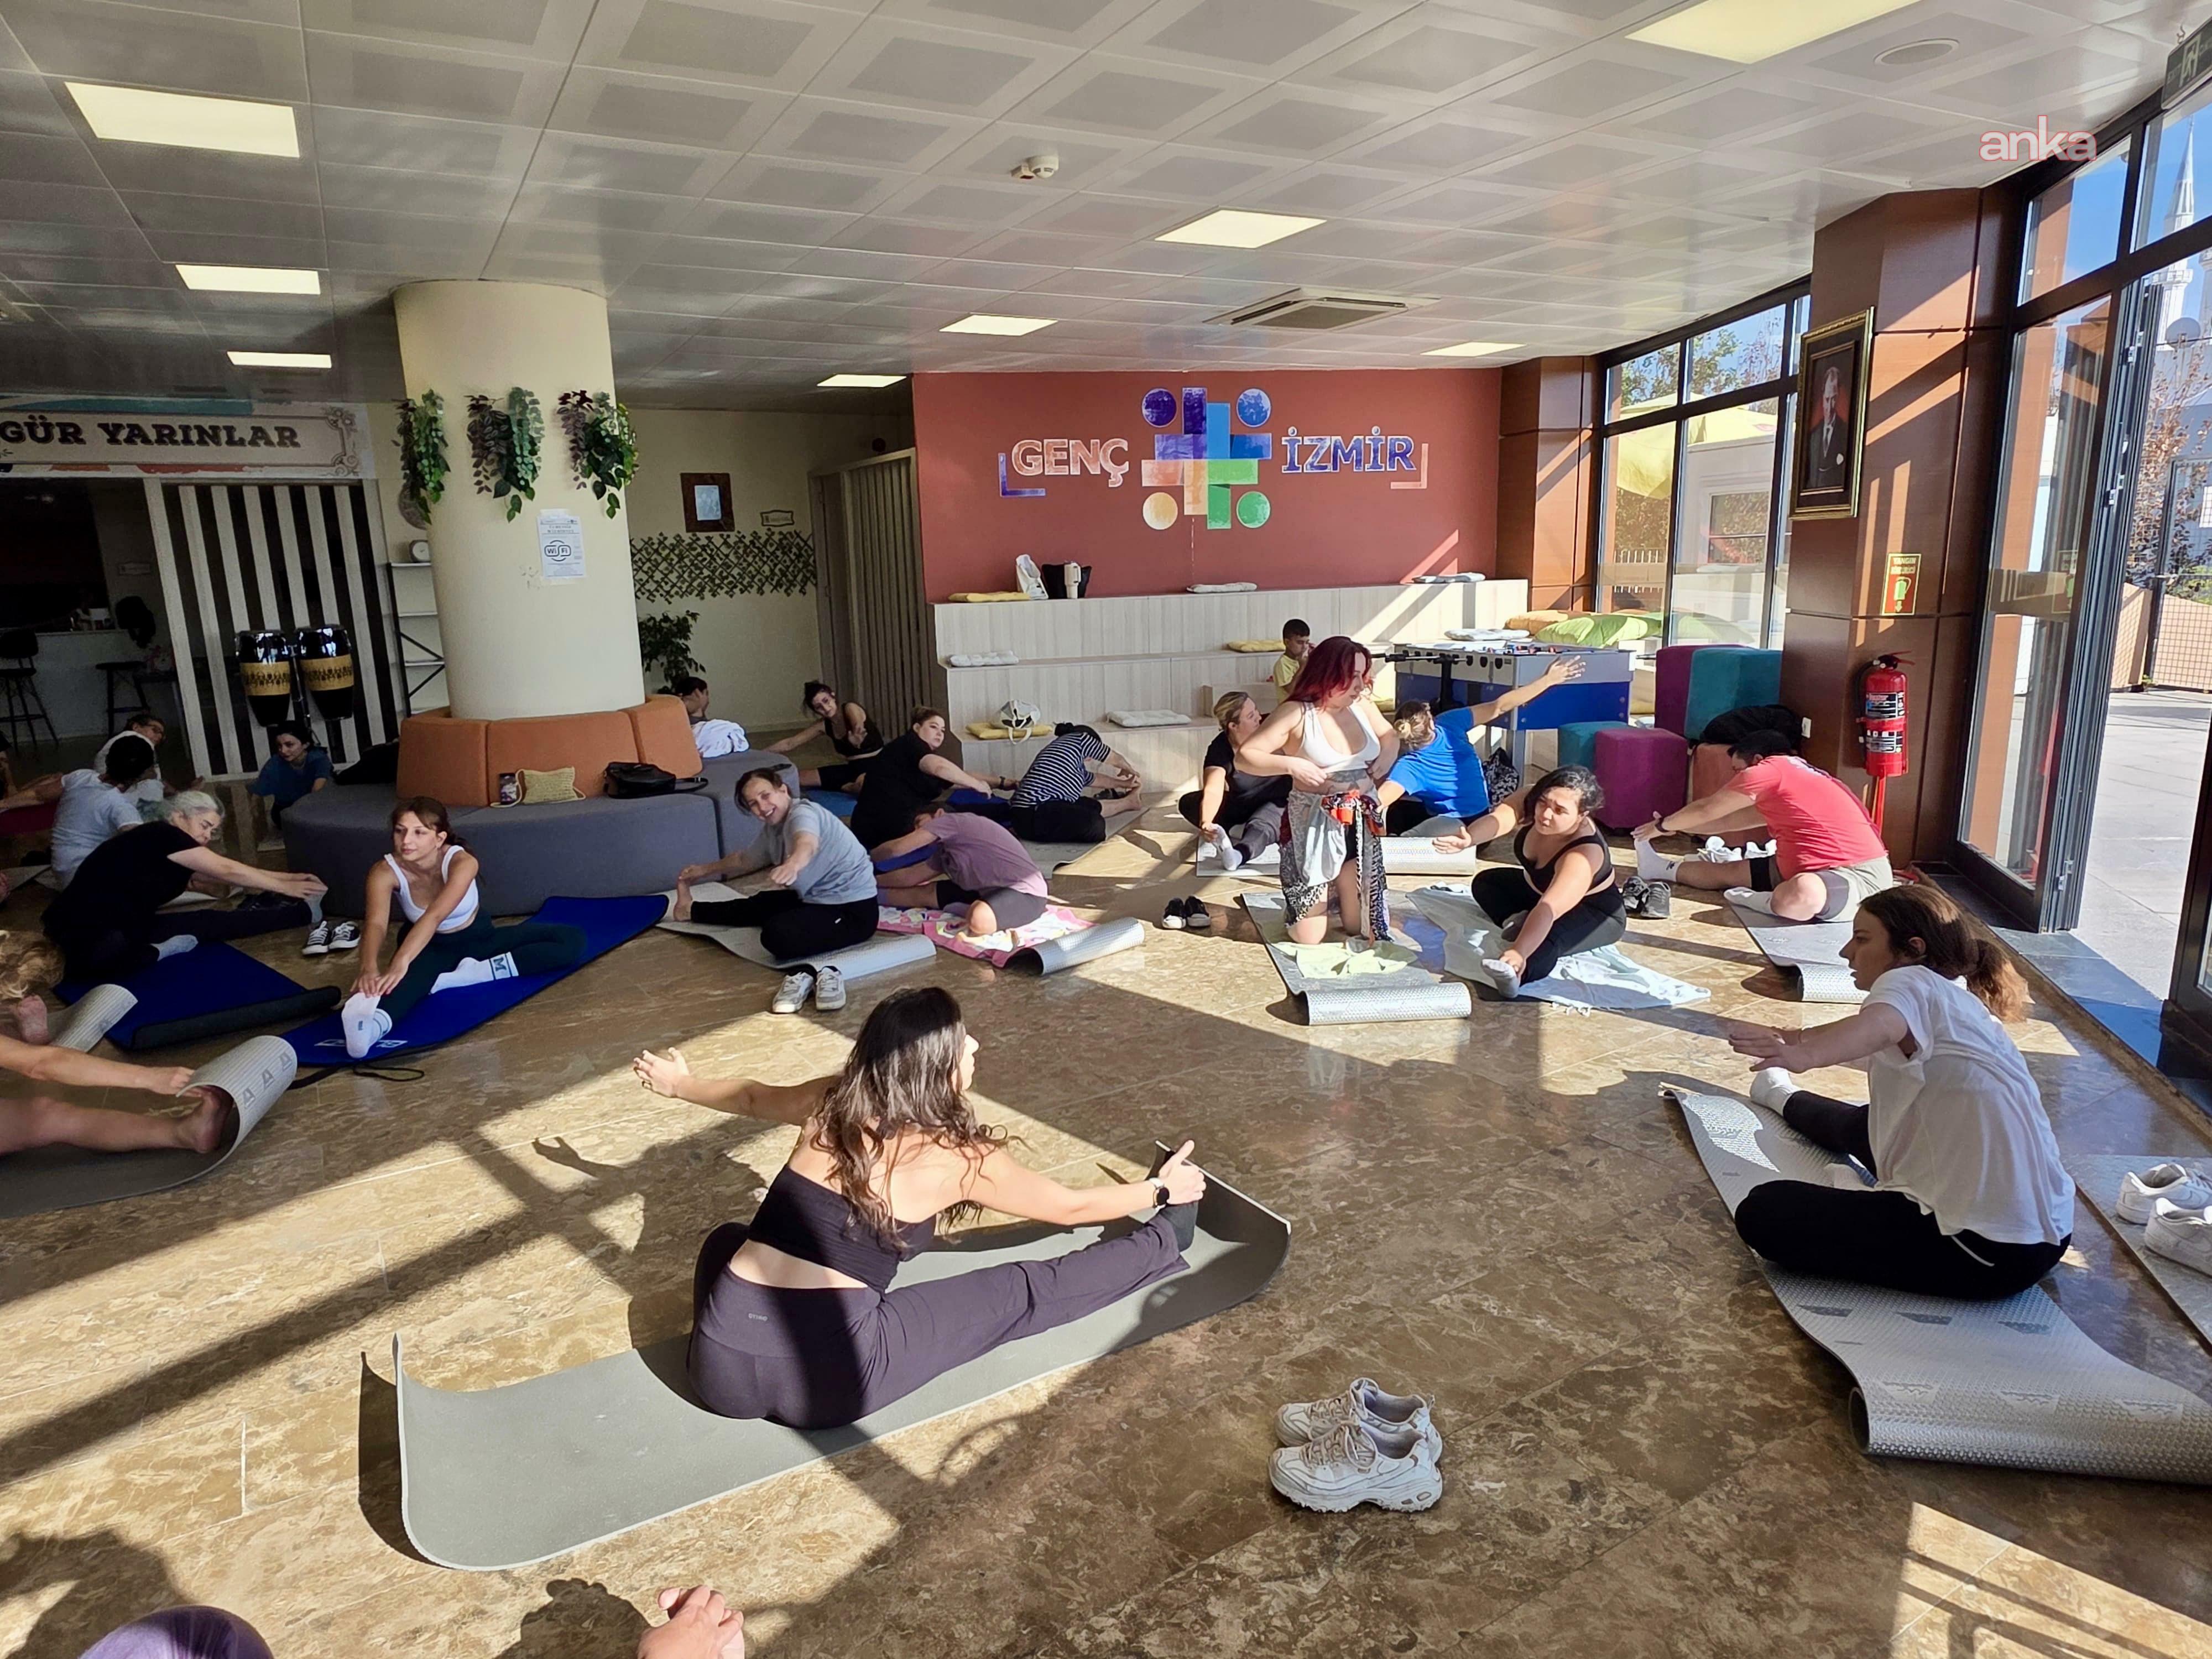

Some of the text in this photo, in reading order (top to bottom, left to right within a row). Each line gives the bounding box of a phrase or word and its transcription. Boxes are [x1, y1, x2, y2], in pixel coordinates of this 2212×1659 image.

[0, 415, 301, 448] GÜR YARINLAR
[1011, 425, 1417, 487] GENÇ İZMİR
